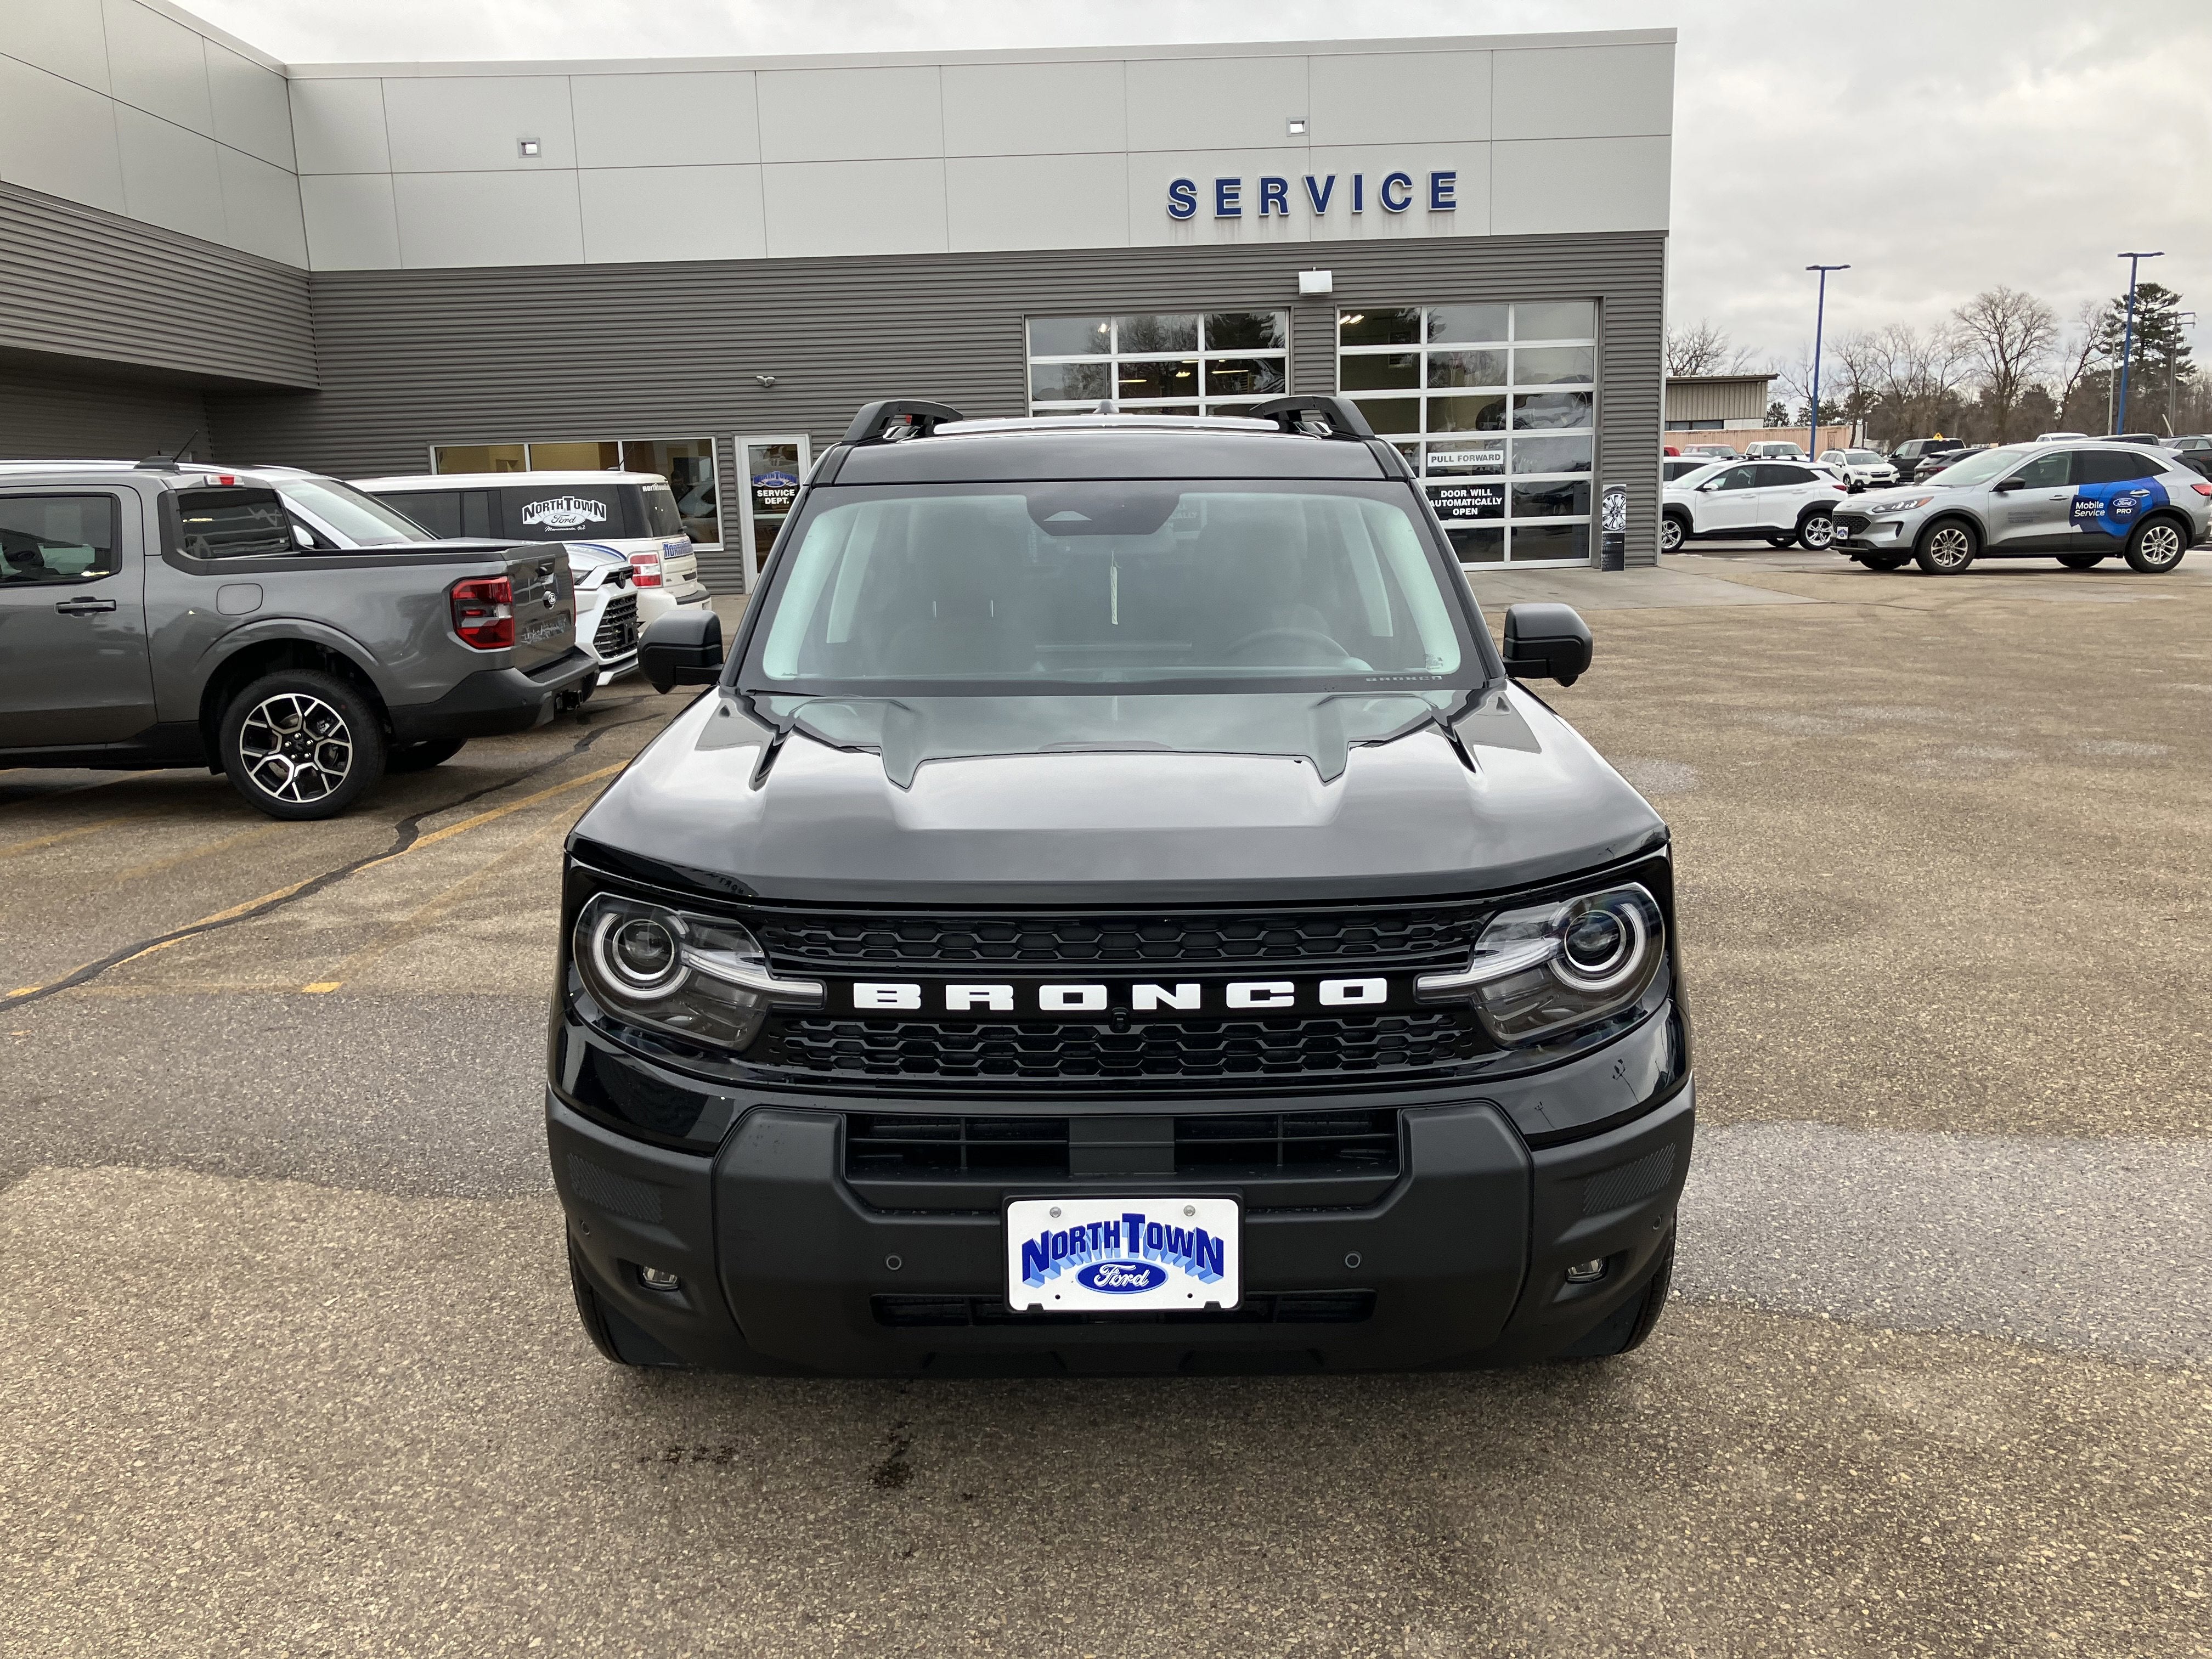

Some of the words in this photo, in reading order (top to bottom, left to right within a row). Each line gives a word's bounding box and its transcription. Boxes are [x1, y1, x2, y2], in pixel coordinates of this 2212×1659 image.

[1167, 170, 1458, 219] SERVICE
[1457, 454, 1501, 462] FORWARD
[1441, 489, 1467, 498] DOOR
[1429, 498, 1502, 507] AUTOMATICALLY
[2075, 501, 2104, 509] Mobile
[551, 514, 577, 524] Ford
[853, 978, 1387, 1011] BRONCO
[1093, 1263, 1150, 1287] Ford
